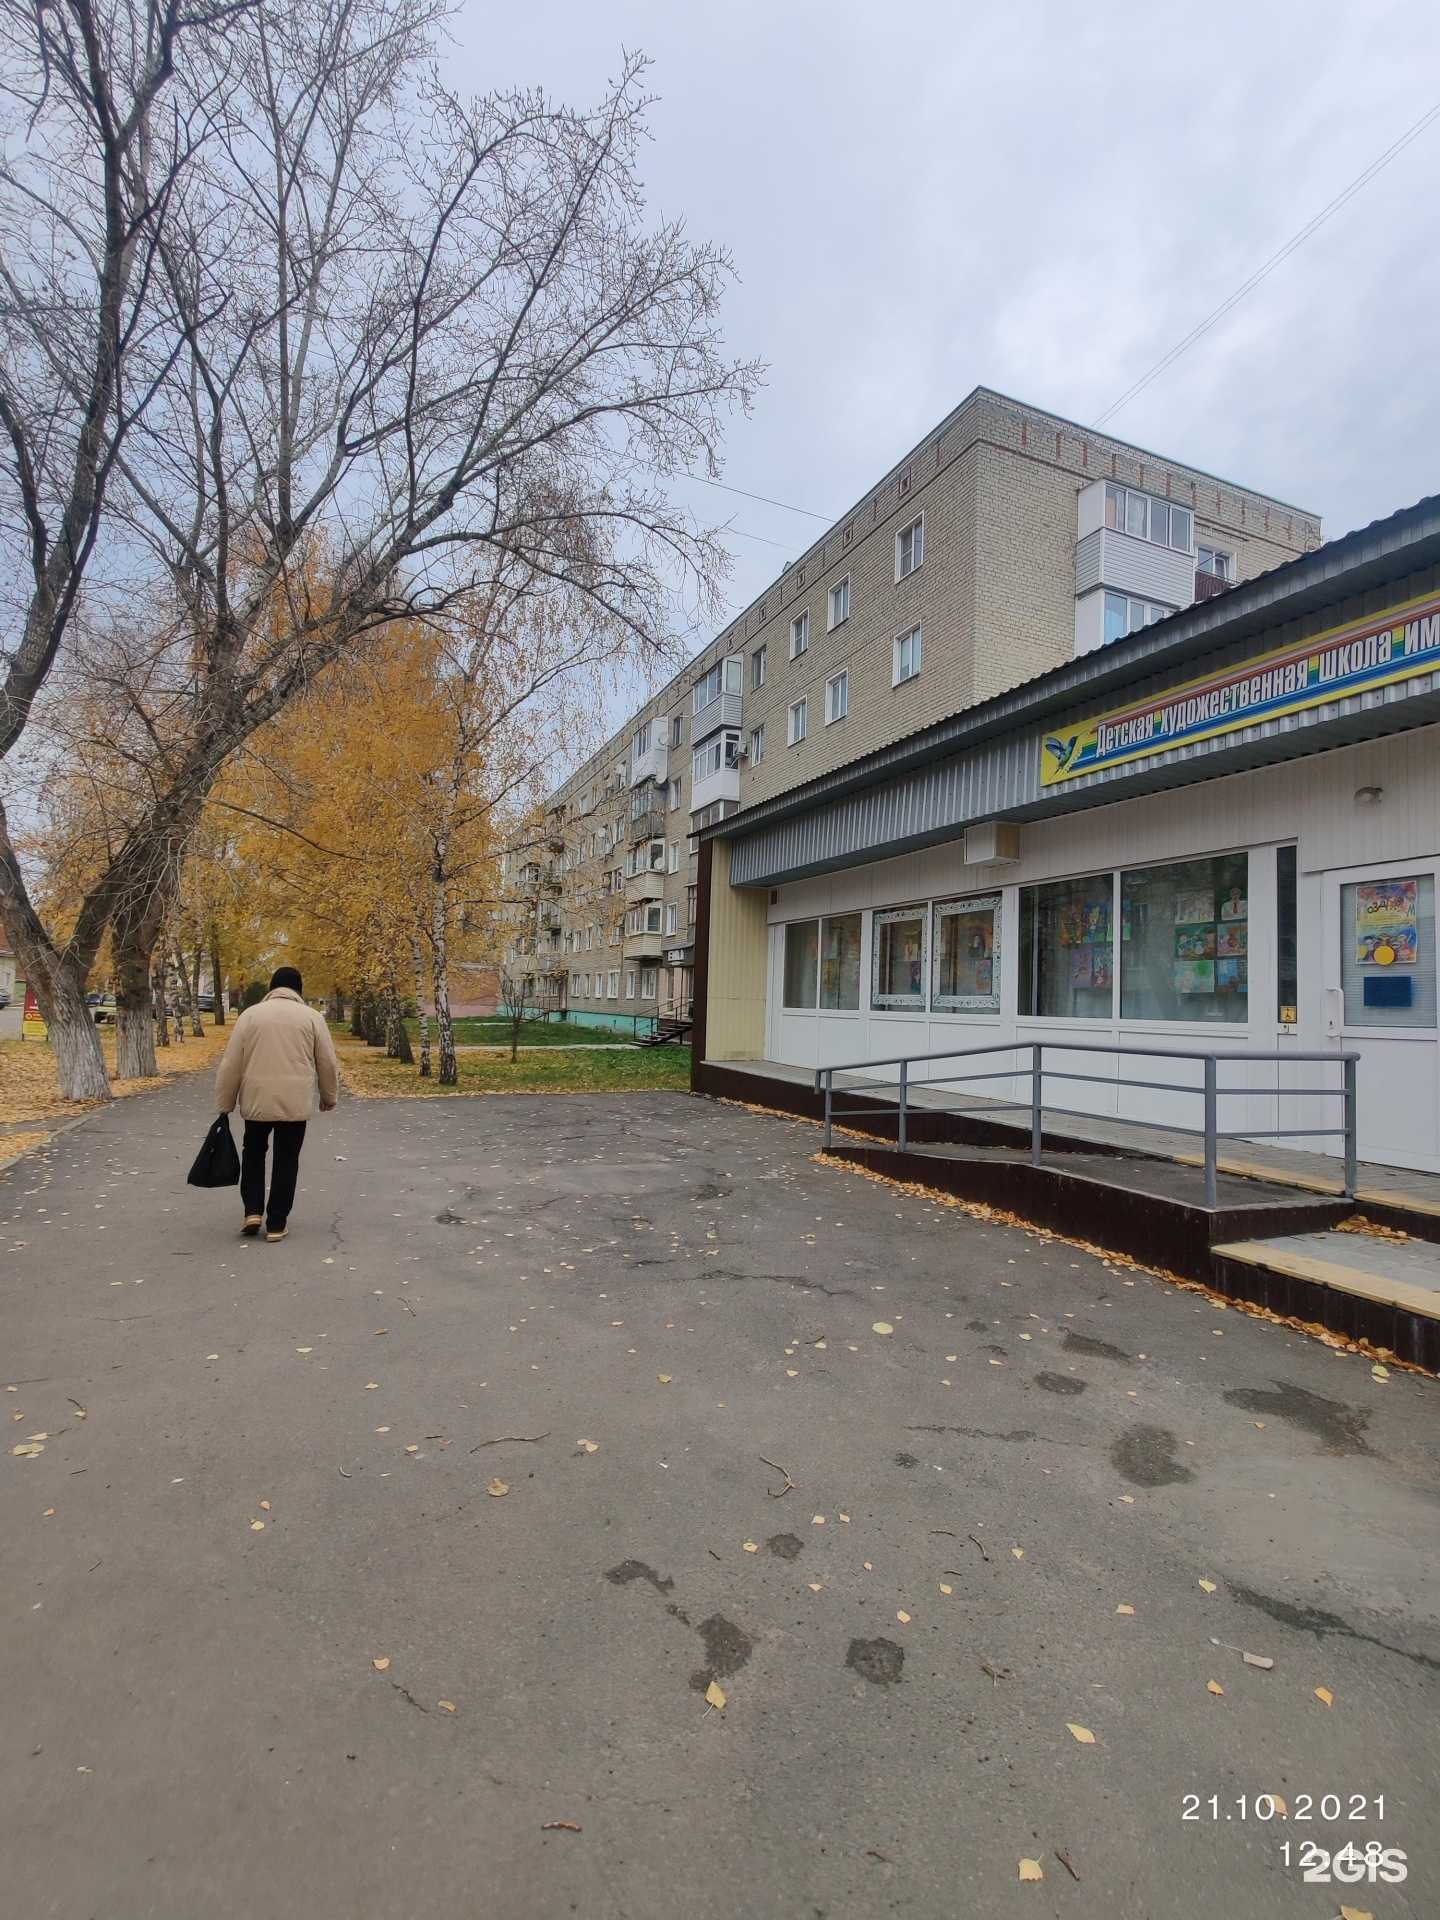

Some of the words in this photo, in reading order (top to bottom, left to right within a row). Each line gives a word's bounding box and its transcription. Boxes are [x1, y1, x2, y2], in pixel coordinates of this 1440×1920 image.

[1096, 712, 1155, 758] Детская
[1160, 659, 1308, 736] художественная
[1318, 630, 1392, 683] школа
